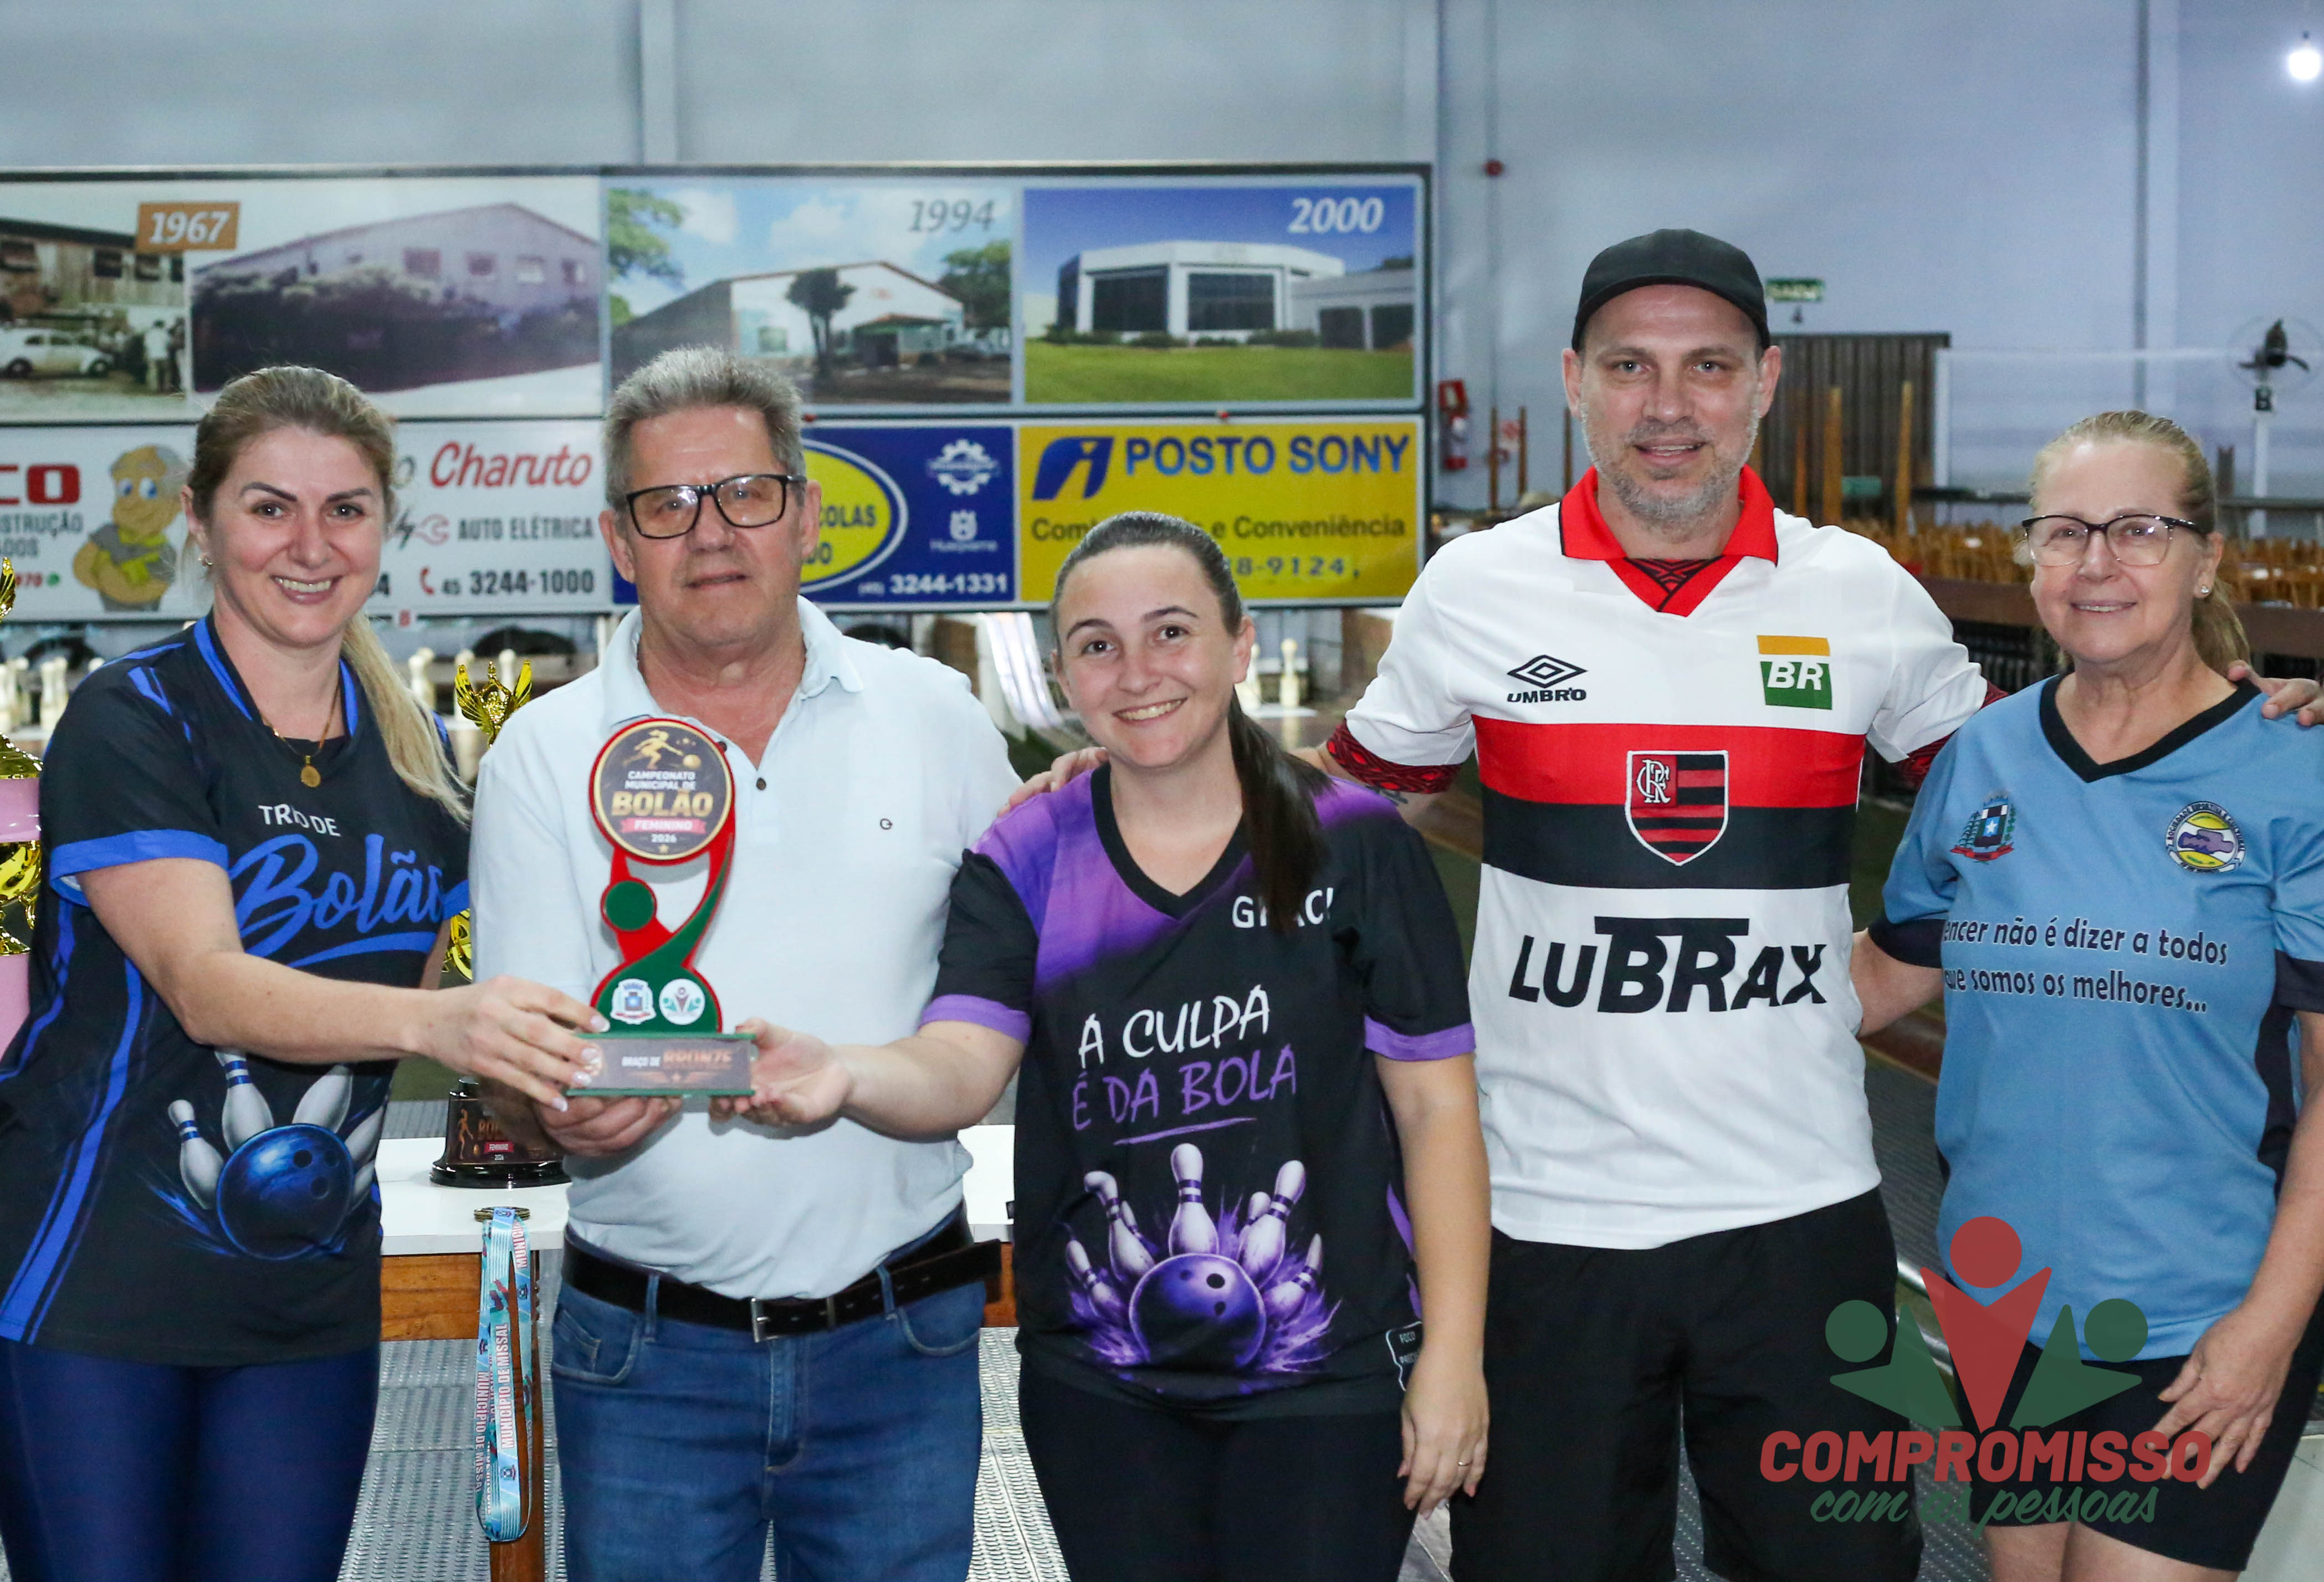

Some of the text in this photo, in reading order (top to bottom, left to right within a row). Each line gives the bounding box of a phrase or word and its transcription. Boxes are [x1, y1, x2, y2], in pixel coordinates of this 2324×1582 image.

[149, 211, 229, 244] 1967
[908, 198, 996, 232] 1994
[1288, 197, 1384, 234] 2000
[430, 441, 592, 488] Charuto
[1125, 434, 1410, 475] POSTO SONY
[458, 511, 594, 541] AUTO ELÉTRICA
[1233, 514, 1406, 540] Conveniência
[469, 569, 595, 595] 3244-1000
[890, 573, 1008, 595] 3244-1331
[1767, 662, 1824, 692] BR
[1507, 687, 1587, 704] UMBRO
[611, 788, 714, 817] BOLÃO
[309, 815, 341, 837] DE
[634, 820, 693, 831] FEMININO
[1993, 917, 2038, 947] não
[2045, 917, 2057, 946] é
[2063, 917, 2126, 952] dizer
[2132, 930, 2148, 954] a
[2158, 928, 2228, 966] todos
[1508, 915, 1828, 1013] LUBRAX
[1972, 966, 2036, 996] somos
[2043, 973, 2065, 997] os
[2072, 969, 2208, 1013] melhores...
[1078, 984, 1271, 1069] A CULPA
[1072, 1043, 1297, 1131] É DA BOLA
[475, 1371, 490, 1433] MUNICÍPIO
[495, 1323, 515, 1450] MUNICÍPIO DE MISSAL
[475, 1435, 485, 1450] DE
